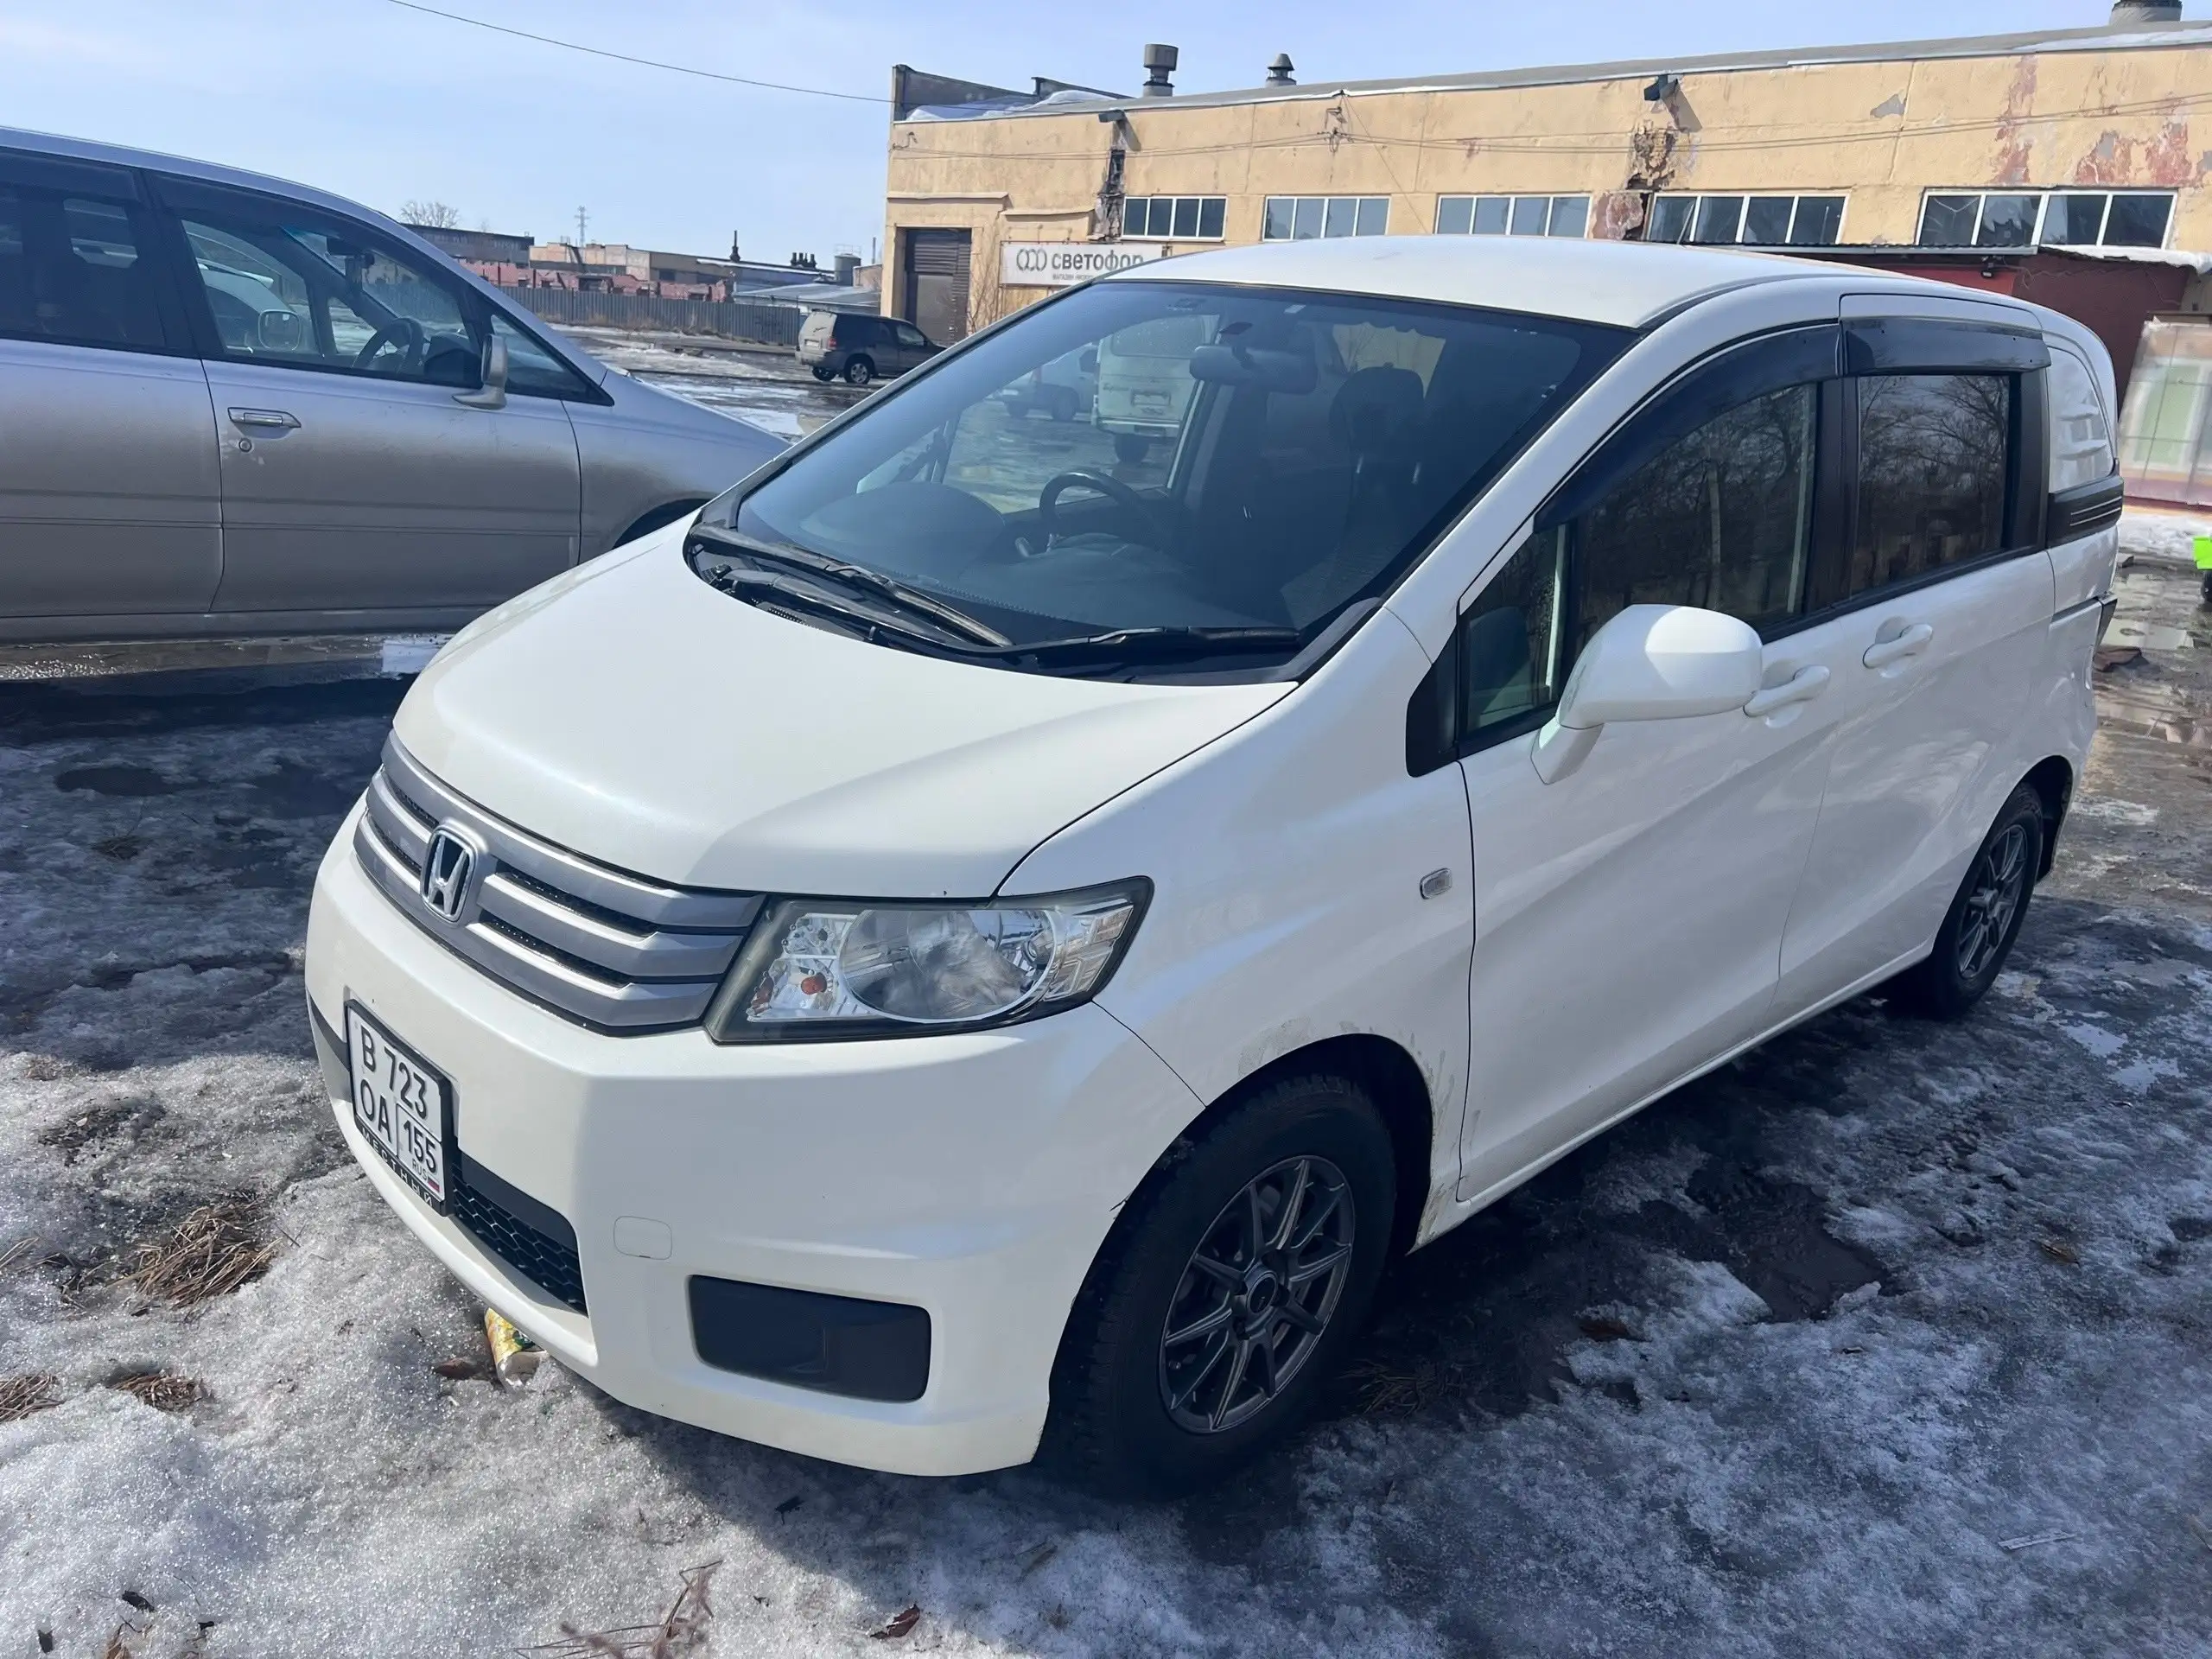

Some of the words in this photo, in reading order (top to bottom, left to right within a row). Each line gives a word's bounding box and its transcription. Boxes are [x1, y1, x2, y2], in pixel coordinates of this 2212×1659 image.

[384, 1046, 428, 1121] 723
[403, 1120, 438, 1174] 155
[411, 1158, 429, 1182] RUS
